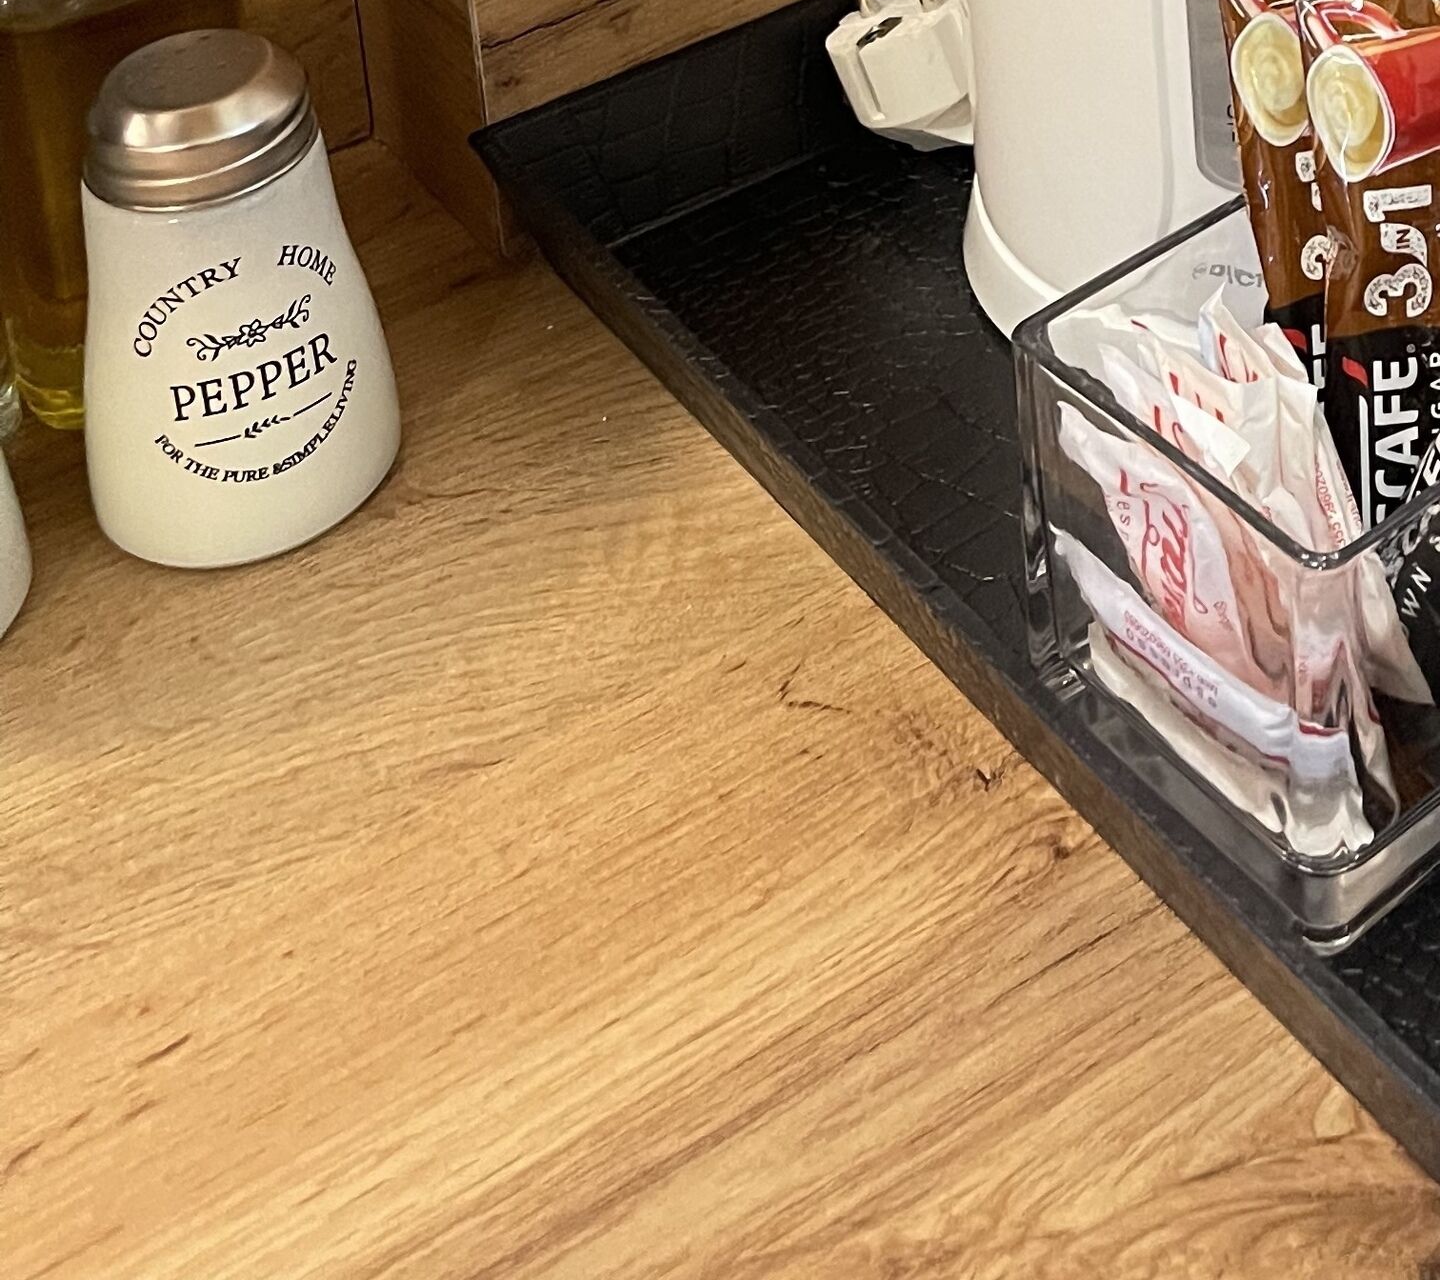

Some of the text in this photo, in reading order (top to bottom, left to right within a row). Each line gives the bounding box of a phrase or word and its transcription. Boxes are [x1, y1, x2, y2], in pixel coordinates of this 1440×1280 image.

[1395, 226, 1412, 249] IN
[132, 243, 338, 359] COUNTRY HOME
[169, 332, 339, 422] PEPPER
[154, 433, 185, 465] FOR
[183, 456, 221, 482] THE
[221, 465, 271, 484] PURE
